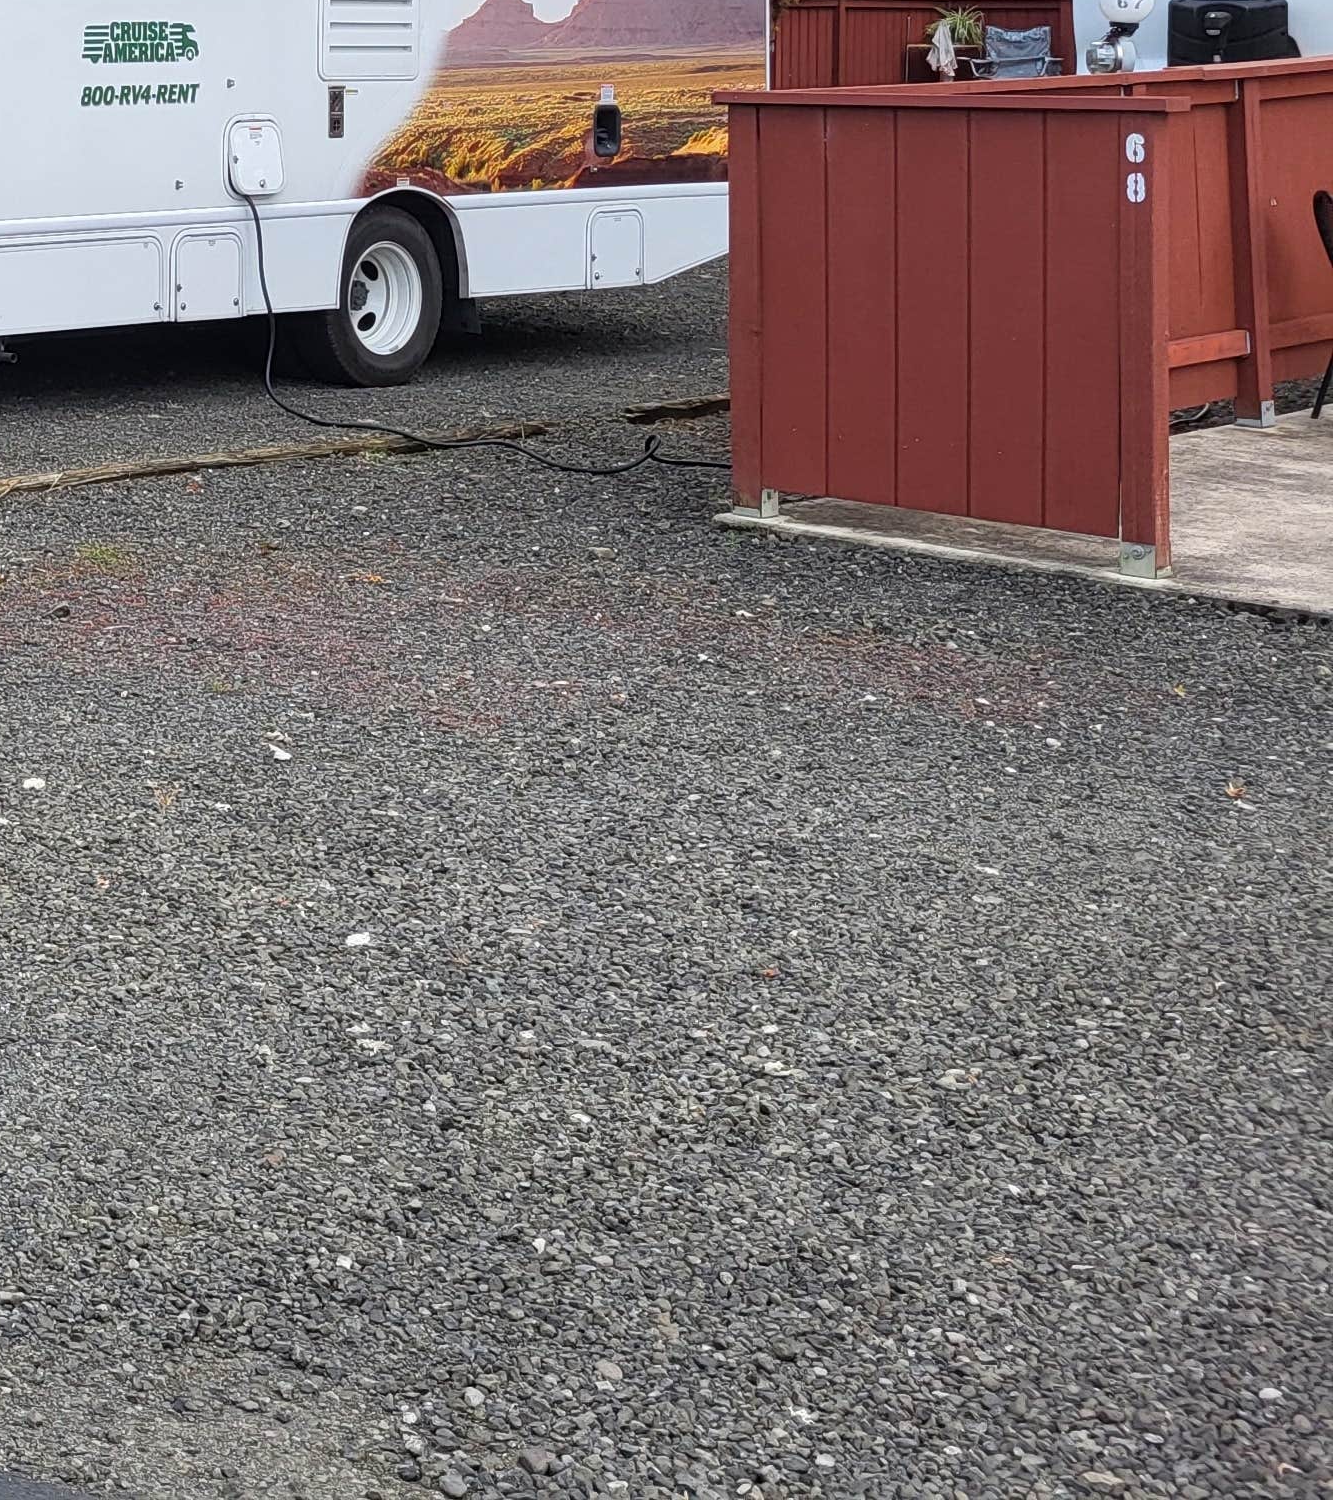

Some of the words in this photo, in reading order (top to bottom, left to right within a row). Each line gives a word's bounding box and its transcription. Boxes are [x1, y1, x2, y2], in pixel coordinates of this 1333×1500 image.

[109, 21, 170, 42] CRUISE
[102, 41, 177, 64] AMERICA
[80, 82, 201, 107] 800-RV4-RENT
